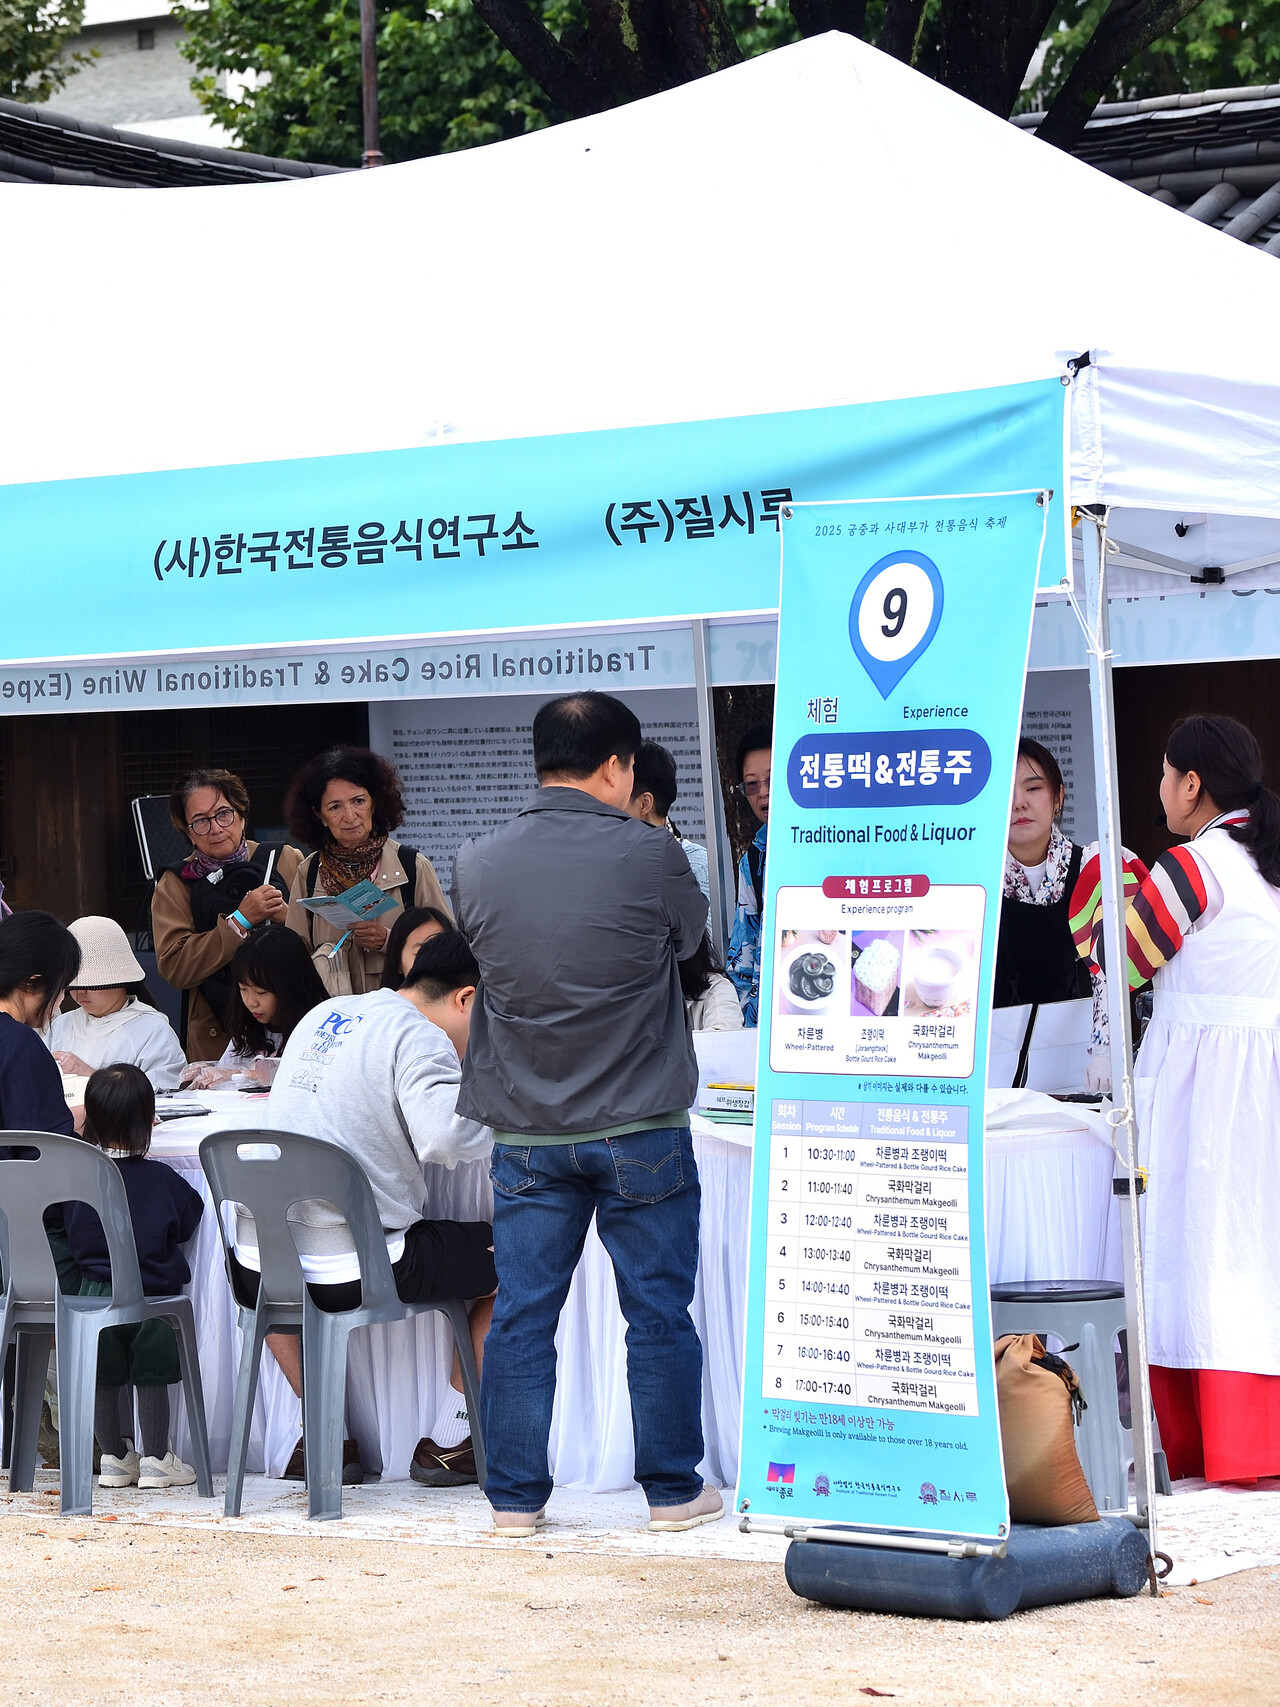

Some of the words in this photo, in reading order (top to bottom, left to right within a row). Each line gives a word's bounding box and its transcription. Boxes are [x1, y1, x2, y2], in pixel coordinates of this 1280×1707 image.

[604, 486, 795, 548] (주)질시루
[815, 524, 841, 537] 2025
[847, 522, 879, 536] 궁중과
[885, 520, 929, 534] 사대부가
[934, 518, 978, 533] 전통음식
[984, 516, 1007, 530] 축제
[153, 509, 540, 581] (사)한국전통음식연구소
[881, 587, 908, 638] 9
[806, 697, 839, 724] 체험
[903, 705, 968, 721] Experience
[799, 749, 972, 789] 전통떡&전통주
[791, 825, 870, 844] Traditional
[874, 823, 907, 842] Food
[910, 826, 918, 841] &
[922, 822, 976, 845] Liquor
[844, 877, 912, 895] 체험프로그램
[841, 904, 885, 915] Experience
[886, 904, 913, 915] program
[913, 1024, 955, 1038] 국화막걸리
[785, 1043, 834, 1052] Wheel-Pattered
[908, 1041, 959, 1050] Chrysanthemum
[918, 1052, 947, 1061] Makgeolli
[931, 1083, 938, 1094] 수
[940, 1084, 969, 1095] 있습니다.
[777, 1104, 796, 1118] 회차
[830, 1106, 845, 1120] 시간
[877, 1108, 910, 1123] 전통음식
[912, 1110, 919, 1122] &
[921, 1110, 948, 1124] 전통주
[771, 1121, 802, 1131] Session
[806, 1122, 835, 1133] Program
[870, 1124, 905, 1136] Traditional
[906, 1126, 924, 1137] Food
[926, 1127, 932, 1137] &
[933, 1128, 956, 1139] Liquor
[783, 1147, 788, 1158] 1
[808, 1148, 855, 1161] 10:30-11:00
[875, 1146, 909, 1160] 차륜병과
[911, 1148, 947, 1163] 조랭이떡
[921, 1163, 938, 1171] Gourd
[952, 1165, 966, 1173] Cake
[781, 1180, 788, 1191] 2
[808, 1181, 853, 1195] 11:00-11:40
[888, 1179, 932, 1195] 국화막걸리
[866, 1194, 920, 1206] Chrysanthemum
[922, 1197, 958, 1208] Makgeolli
[780, 1213, 788, 1224] 3
[805, 1214, 852, 1228] 12:00-12:40
[873, 1213, 907, 1228] 차륜병과
[910, 1216, 947, 1231] 조랭이떡
[920, 1232, 938, 1240] Gourd
[953, 1233, 968, 1241] Cake
[779, 1246, 786, 1257] 4
[803, 1247, 851, 1262] 13:00-13:40
[887, 1247, 932, 1263] 국화막걸리
[864, 1261, 920, 1273] Chrysanthemum
[922, 1265, 959, 1277] Makgeolli
[779, 1279, 785, 1290] 5
[802, 1280, 850, 1296] 14:00-14:40
[873, 1281, 908, 1296] 차륜병과
[911, 1284, 948, 1299] 조랭이떡
[921, 1300, 939, 1308] Gourd
[940, 1301, 953, 1309] Rice
[955, 1302, 970, 1310] Cake
[777, 1312, 785, 1323] 6
[800, 1313, 849, 1329] 15:00-15:40
[888, 1314, 933, 1331] 국화막걸리
[865, 1328, 923, 1341] Chrysanthemum
[924, 1334, 961, 1345] Makgeolli
[777, 1344, 783, 1355] 7
[798, 1346, 850, 1362] 16:00-16:40
[875, 1348, 910, 1363] 차륜병과
[913, 1351, 951, 1367] 조랭이떡
[924, 1367, 942, 1376] Gourd
[775, 1377, 782, 1388] 8
[796, 1379, 851, 1395] 17:00-17:40
[892, 1381, 937, 1398] 국화막걸리
[868, 1395, 927, 1408] Chrysanthemum
[929, 1400, 966, 1412] Makgeolli
[772, 1408, 792, 1422] 막걸리
[819, 1412, 846, 1427] 만18세
[848, 1414, 875, 1429] 이상만
[877, 1417, 895, 1431] 가능
[769, 1424, 791, 1436] Brewing
[792, 1427, 824, 1438] Makgeolli
[825, 1429, 831, 1437] is
[833, 1430, 846, 1440] only
[848, 1432, 877, 1442] available
[878, 1434, 886, 1442] to
[887, 1436, 905, 1444] those
[925, 1438, 932, 1447] 18
[934, 1441, 953, 1449] years
[779, 1487, 794, 1499] 종로
